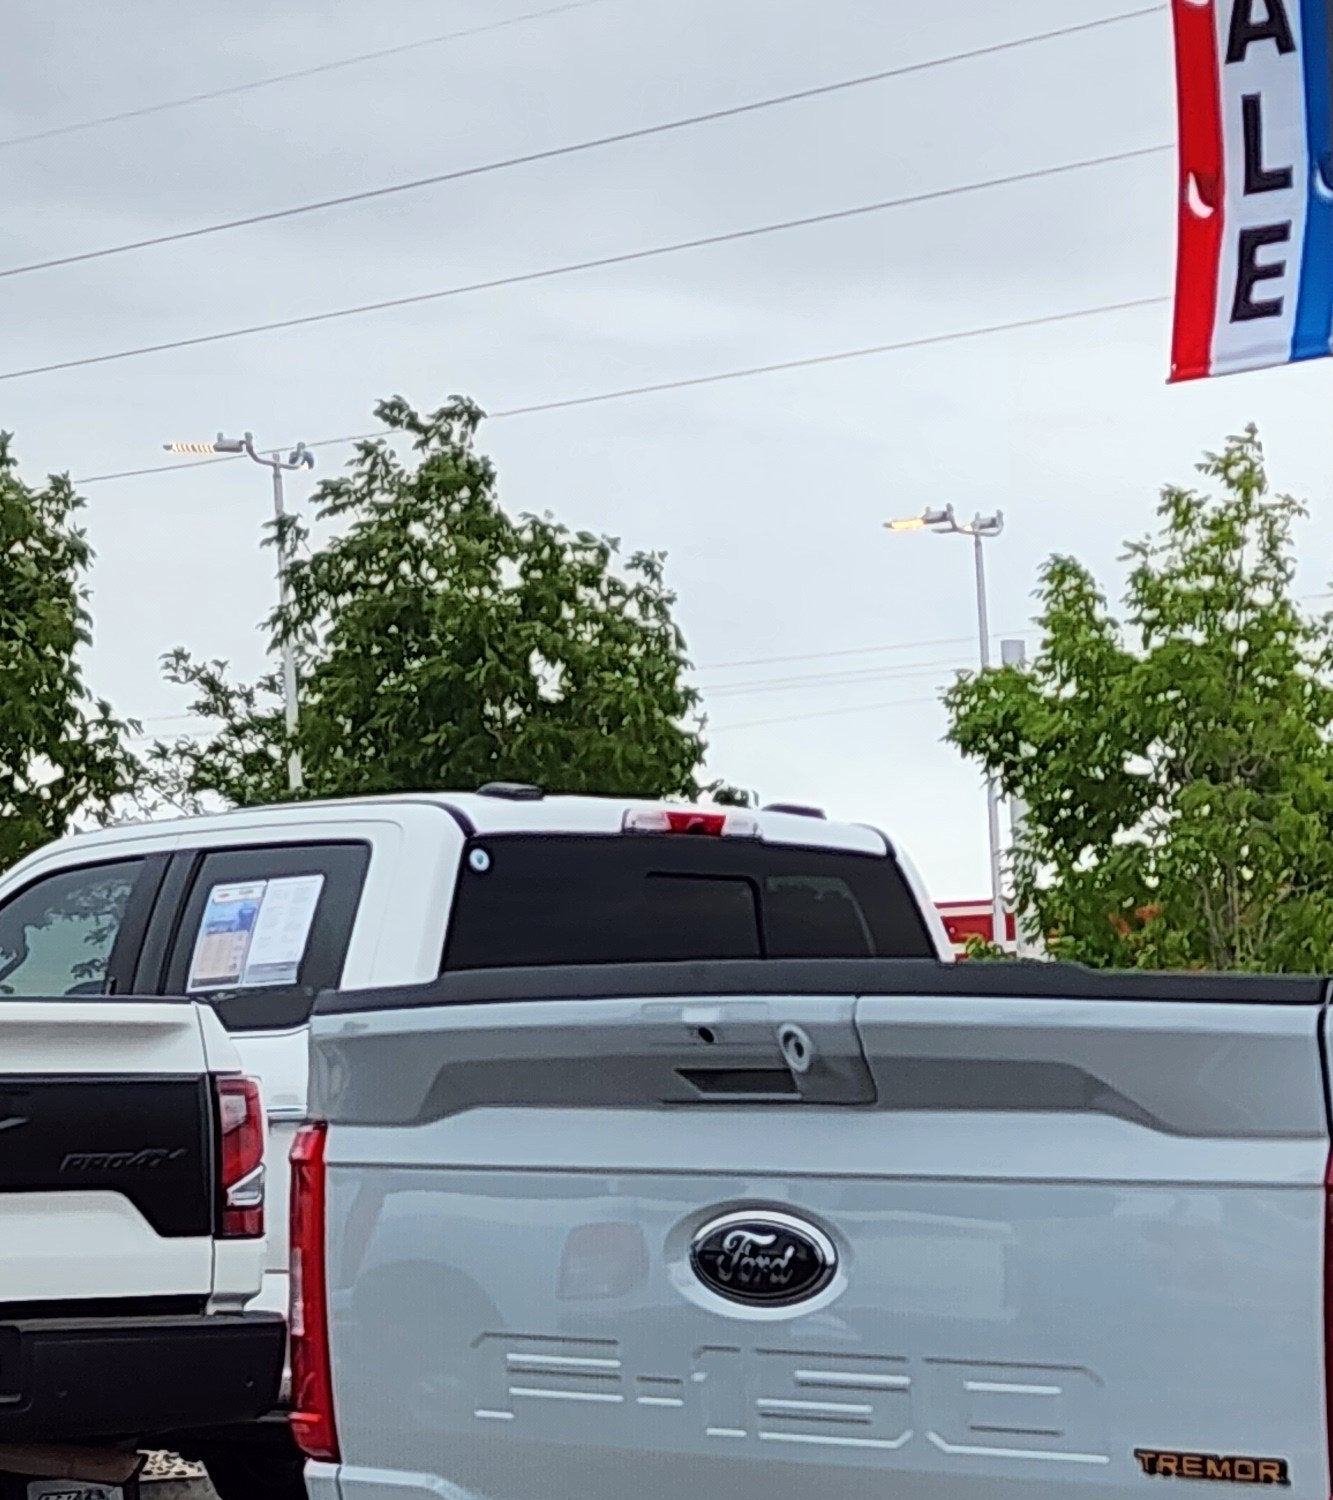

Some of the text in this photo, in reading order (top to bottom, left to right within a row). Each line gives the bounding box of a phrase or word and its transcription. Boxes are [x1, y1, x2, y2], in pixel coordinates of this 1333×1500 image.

[716, 1229, 796, 1285] Ford
[469, 1331, 1112, 1464] F-150
[1136, 1452, 1284, 1483] TREMOR
